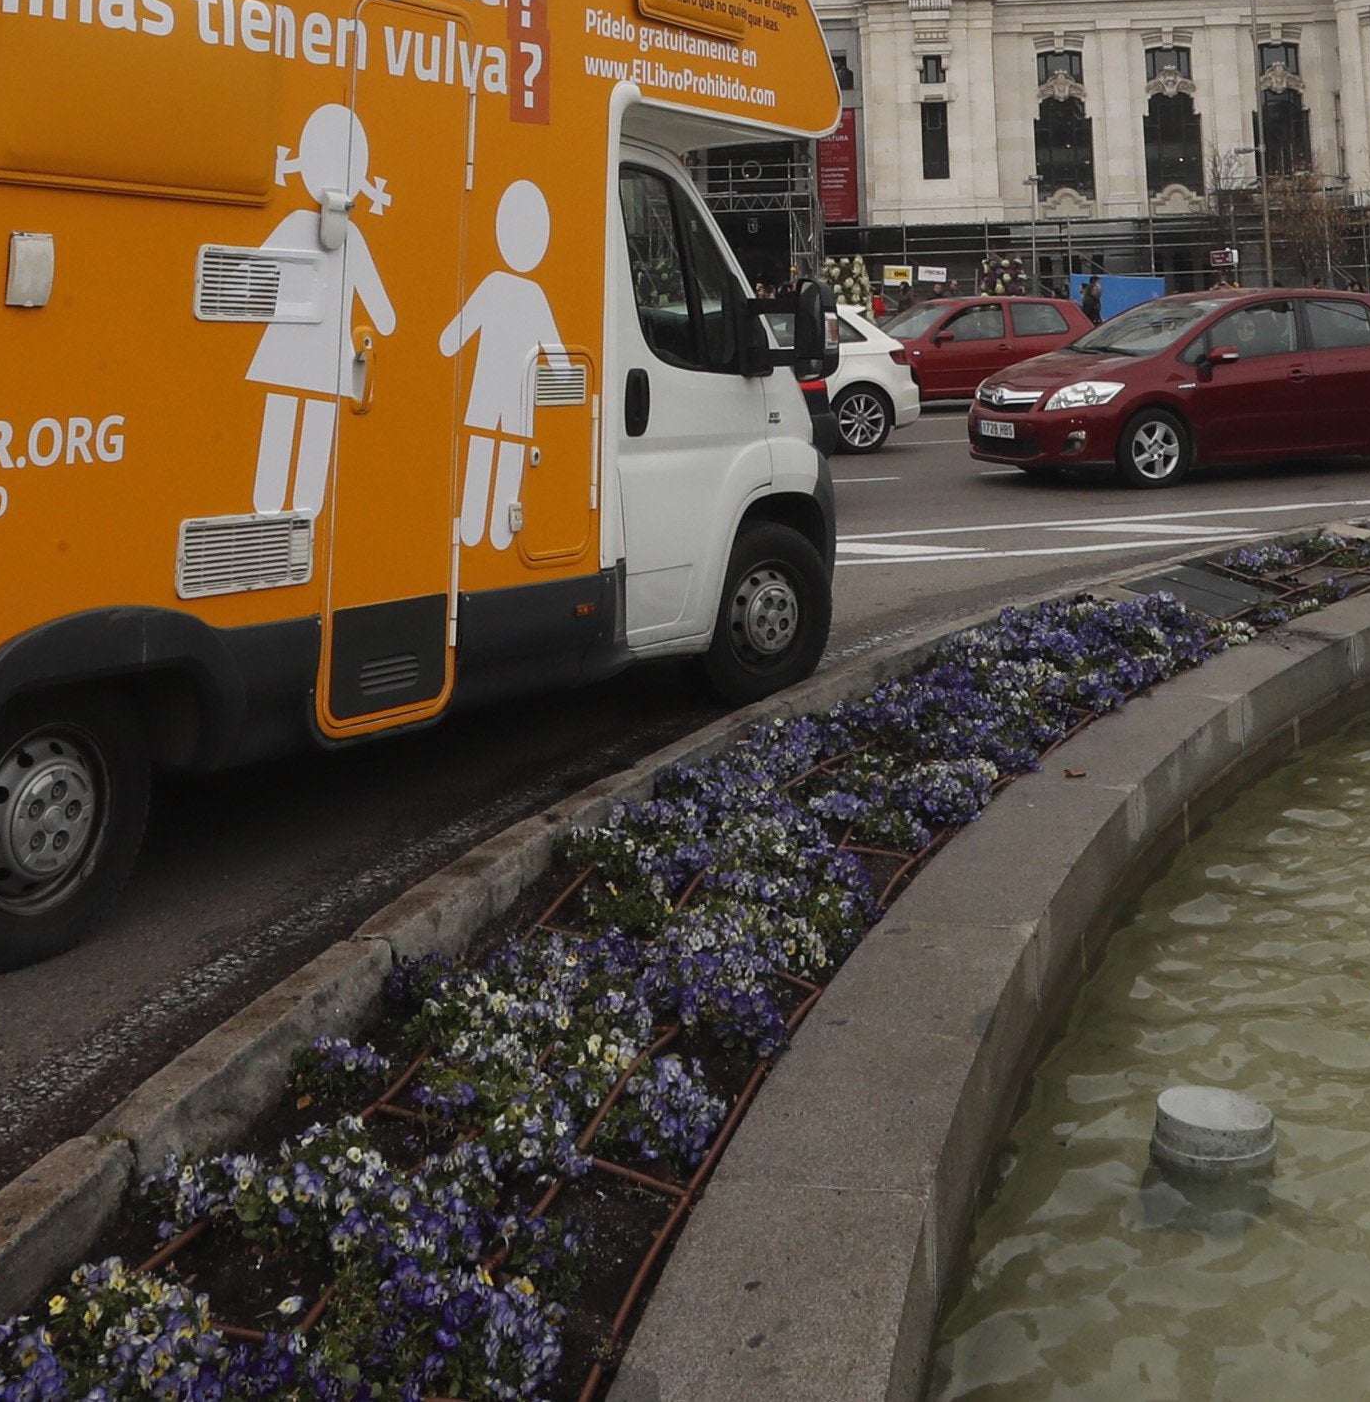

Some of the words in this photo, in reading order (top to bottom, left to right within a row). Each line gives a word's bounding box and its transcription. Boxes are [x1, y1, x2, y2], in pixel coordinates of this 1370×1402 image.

[585, 8, 636, 42] Pídelo
[639, 25, 740, 65] gratuitamente
[742, 49, 757, 67] en
[716, 1, 727, 13] no
[748, 14, 762, 28] que
[385, 20, 508, 95] vulva
